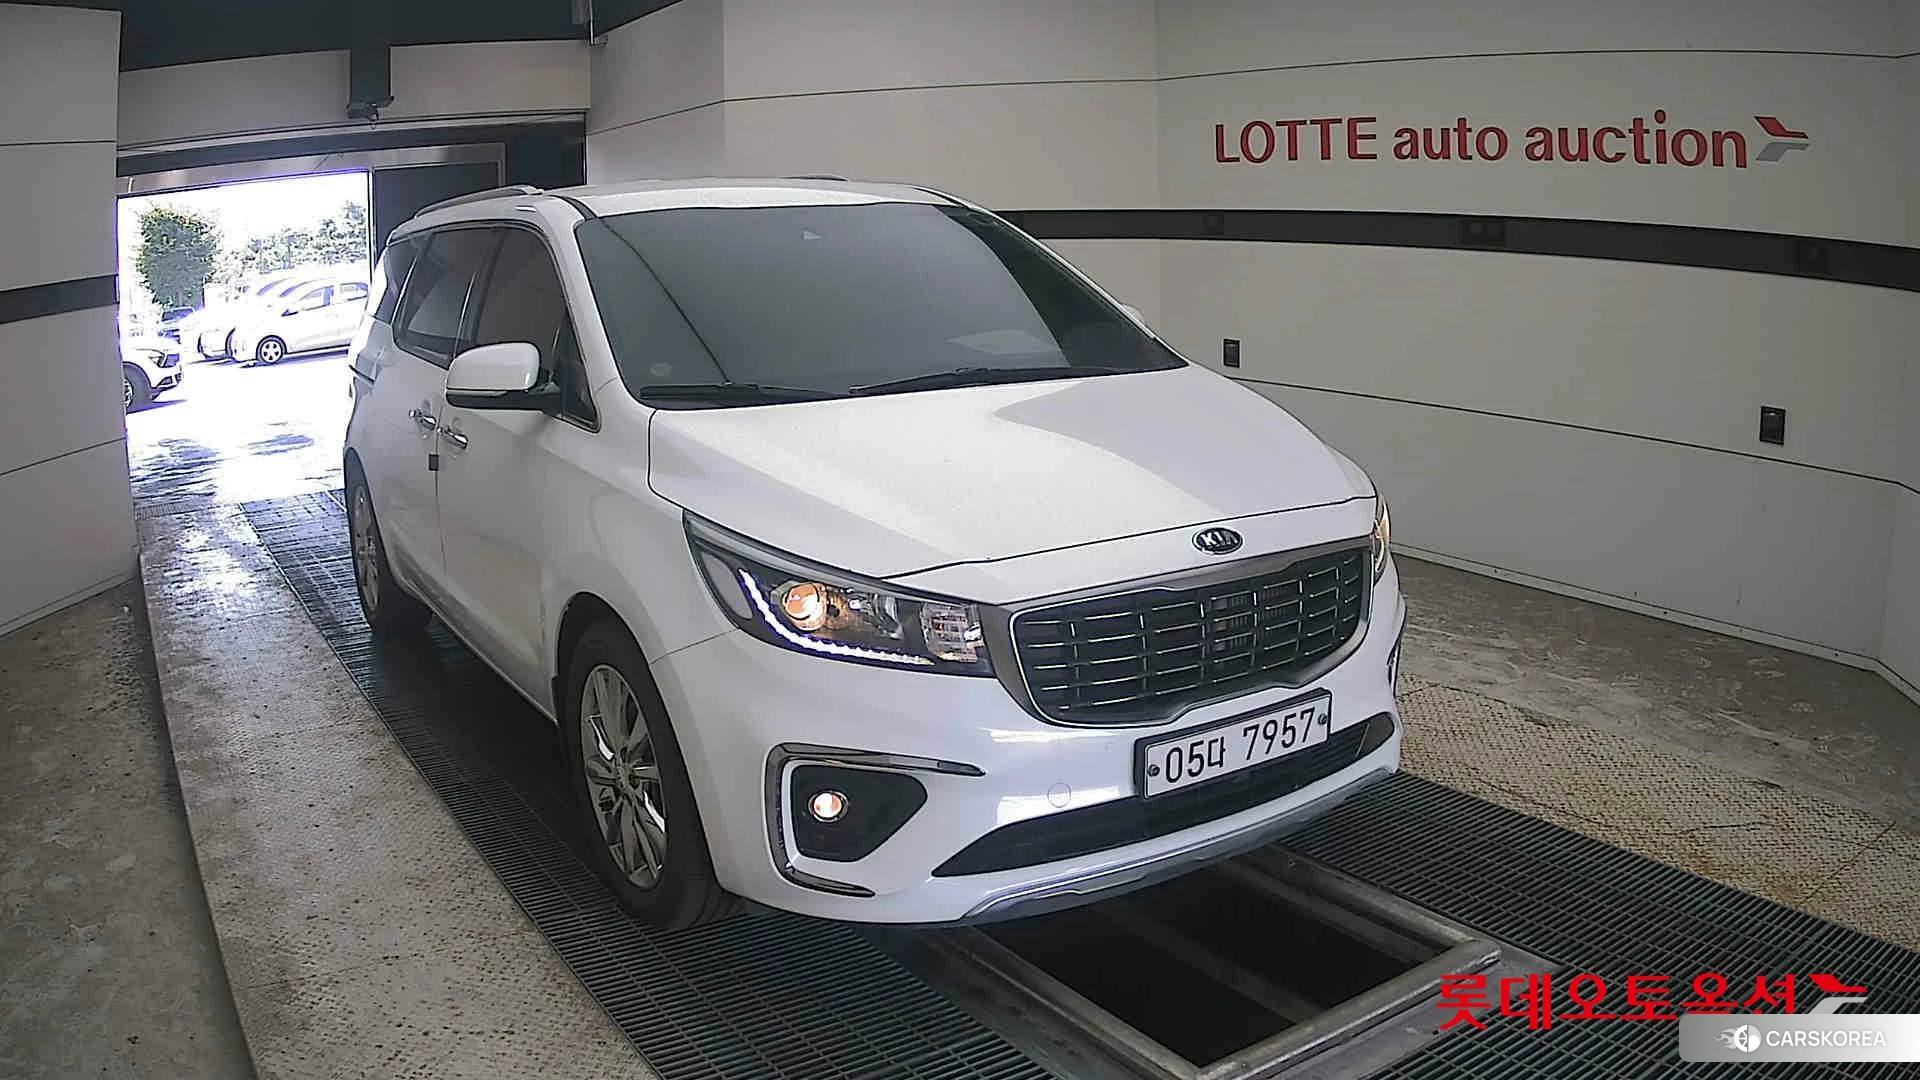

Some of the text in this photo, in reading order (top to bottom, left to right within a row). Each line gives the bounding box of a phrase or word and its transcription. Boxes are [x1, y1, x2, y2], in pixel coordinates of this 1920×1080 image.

[1215, 109, 1747, 169] LOTTE auto auction
[1197, 530, 1240, 549] KIA
[1166, 707, 1315, 783] 05다 7957
